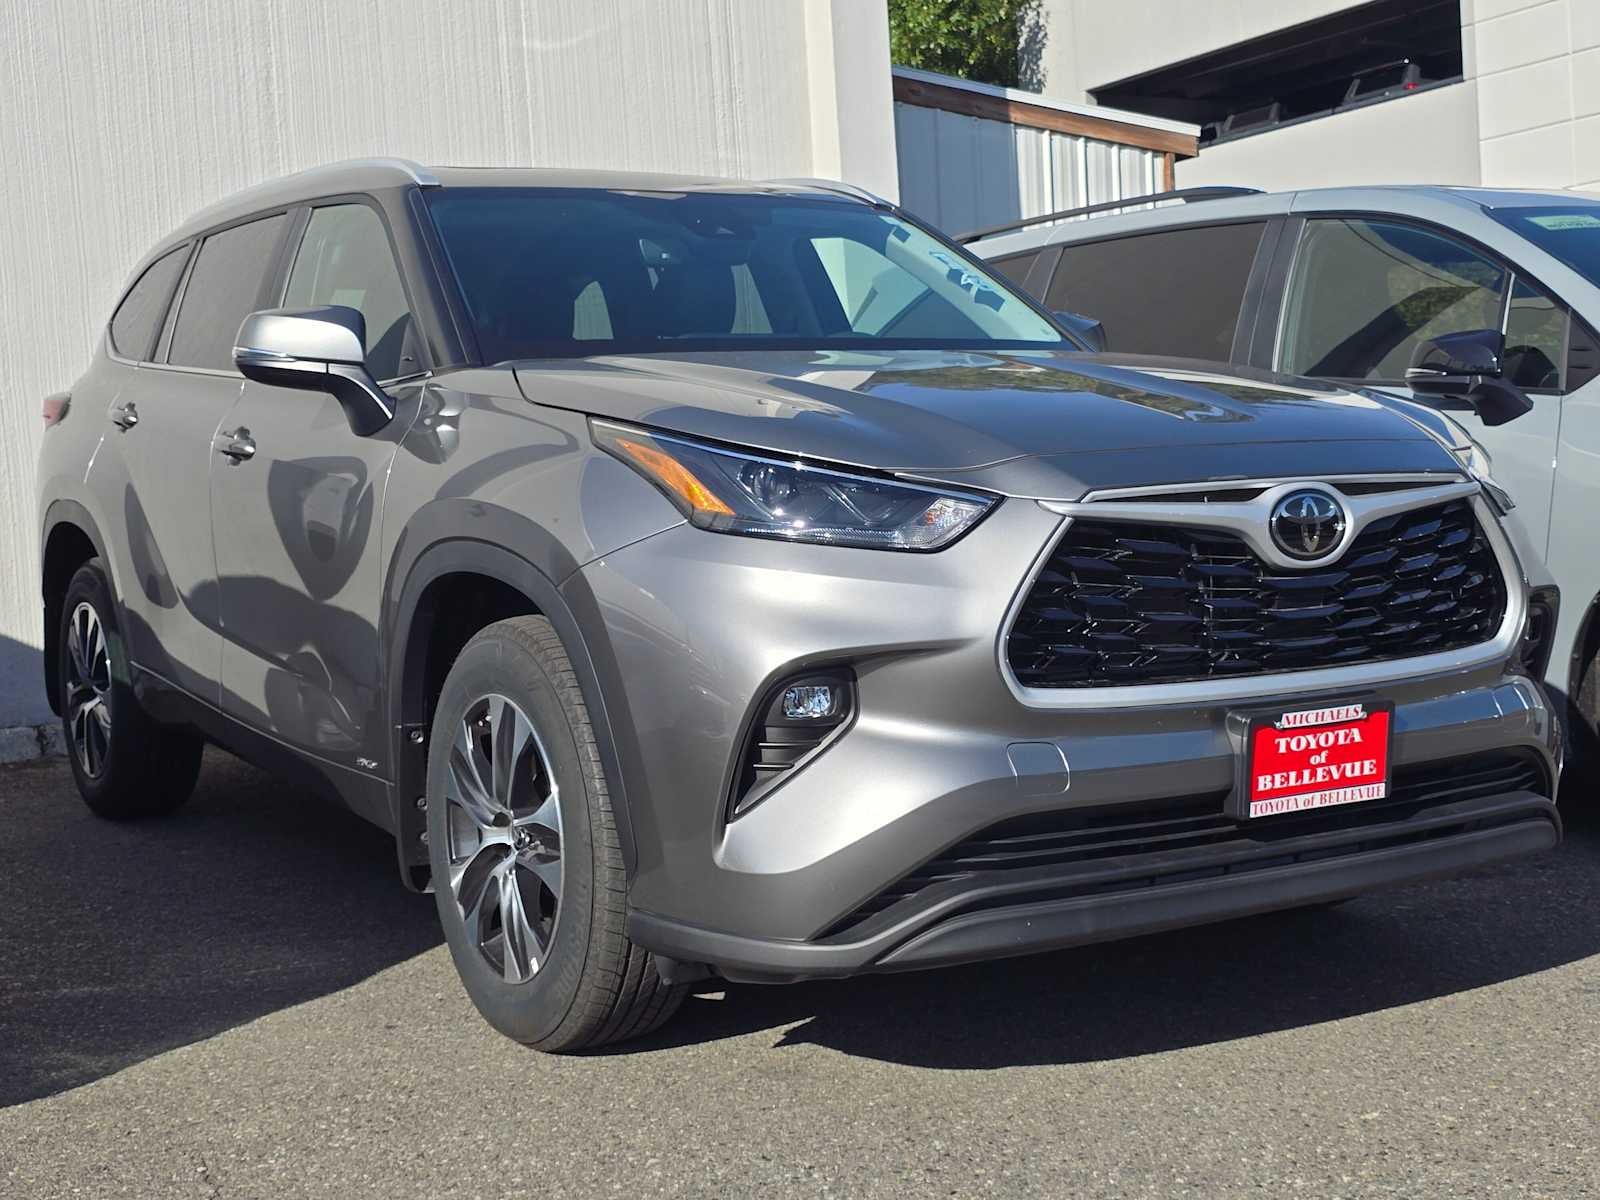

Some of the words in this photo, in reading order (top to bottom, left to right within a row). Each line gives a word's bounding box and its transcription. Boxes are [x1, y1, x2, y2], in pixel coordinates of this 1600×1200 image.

[1283, 705, 1361, 726] MICHAELS
[1275, 727, 1362, 754] TOYOTA
[1309, 750, 1329, 766] of
[1257, 759, 1377, 792] BELLEVUE
[1252, 800, 1299, 816] TOYOTA
[1303, 796, 1316, 808] of
[1319, 784, 1384, 805] BELLEVUE
